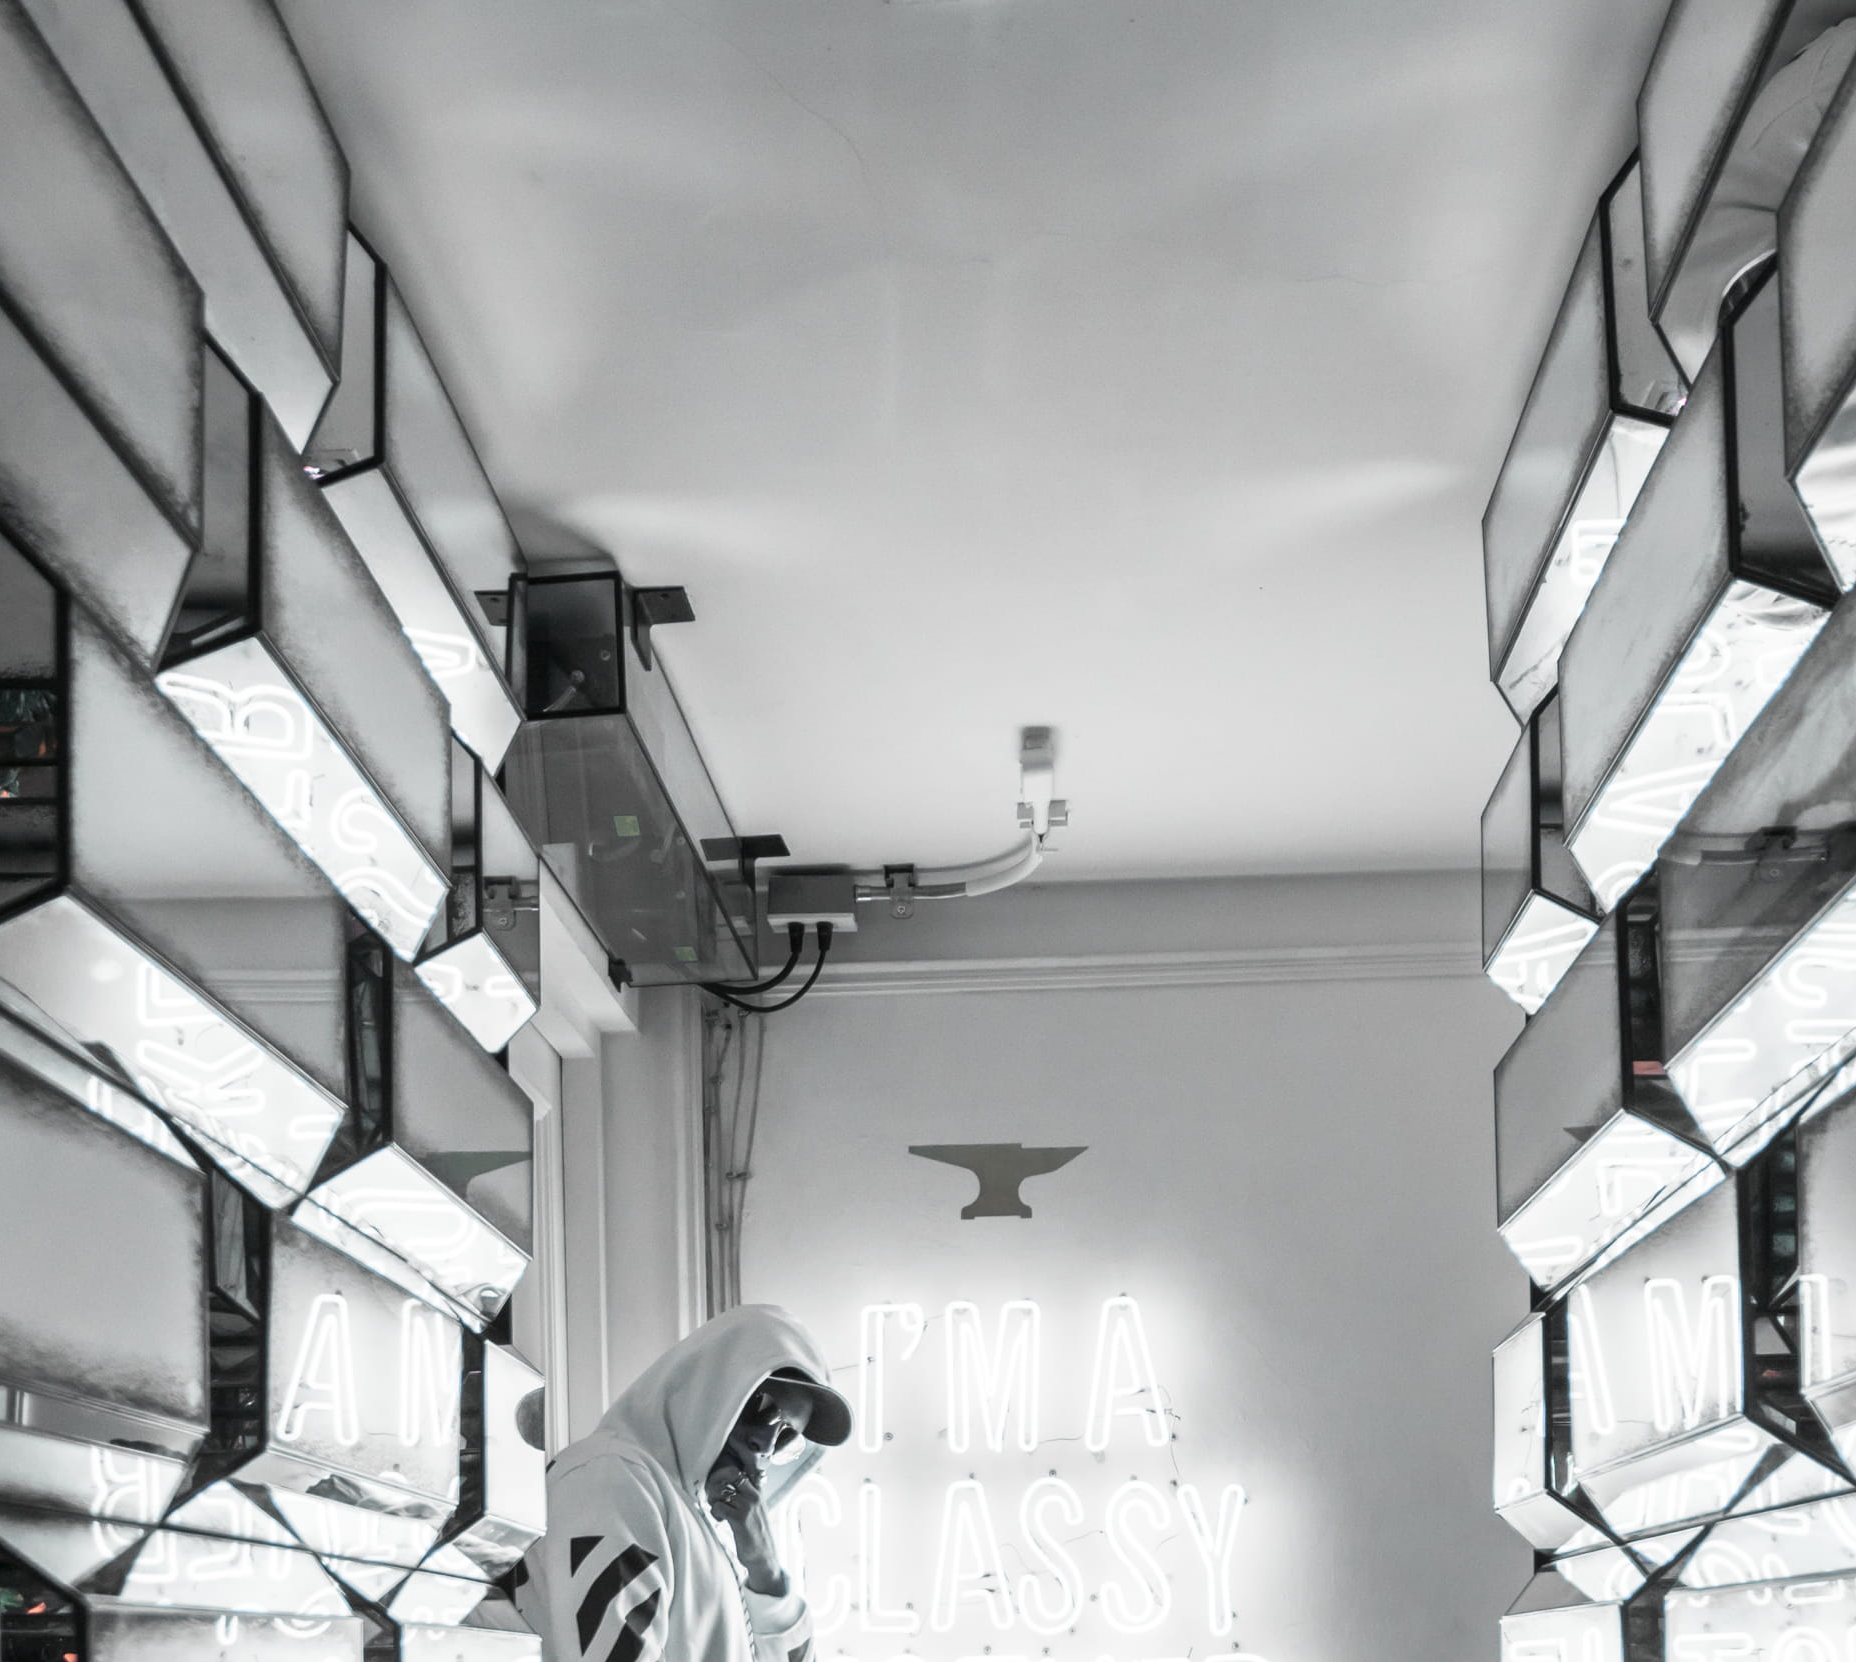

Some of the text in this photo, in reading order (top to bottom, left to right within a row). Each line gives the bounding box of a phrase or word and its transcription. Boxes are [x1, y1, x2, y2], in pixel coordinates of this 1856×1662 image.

[857, 1297, 1170, 1455] I'M A
[783, 1473, 1244, 1635] CLASSY
